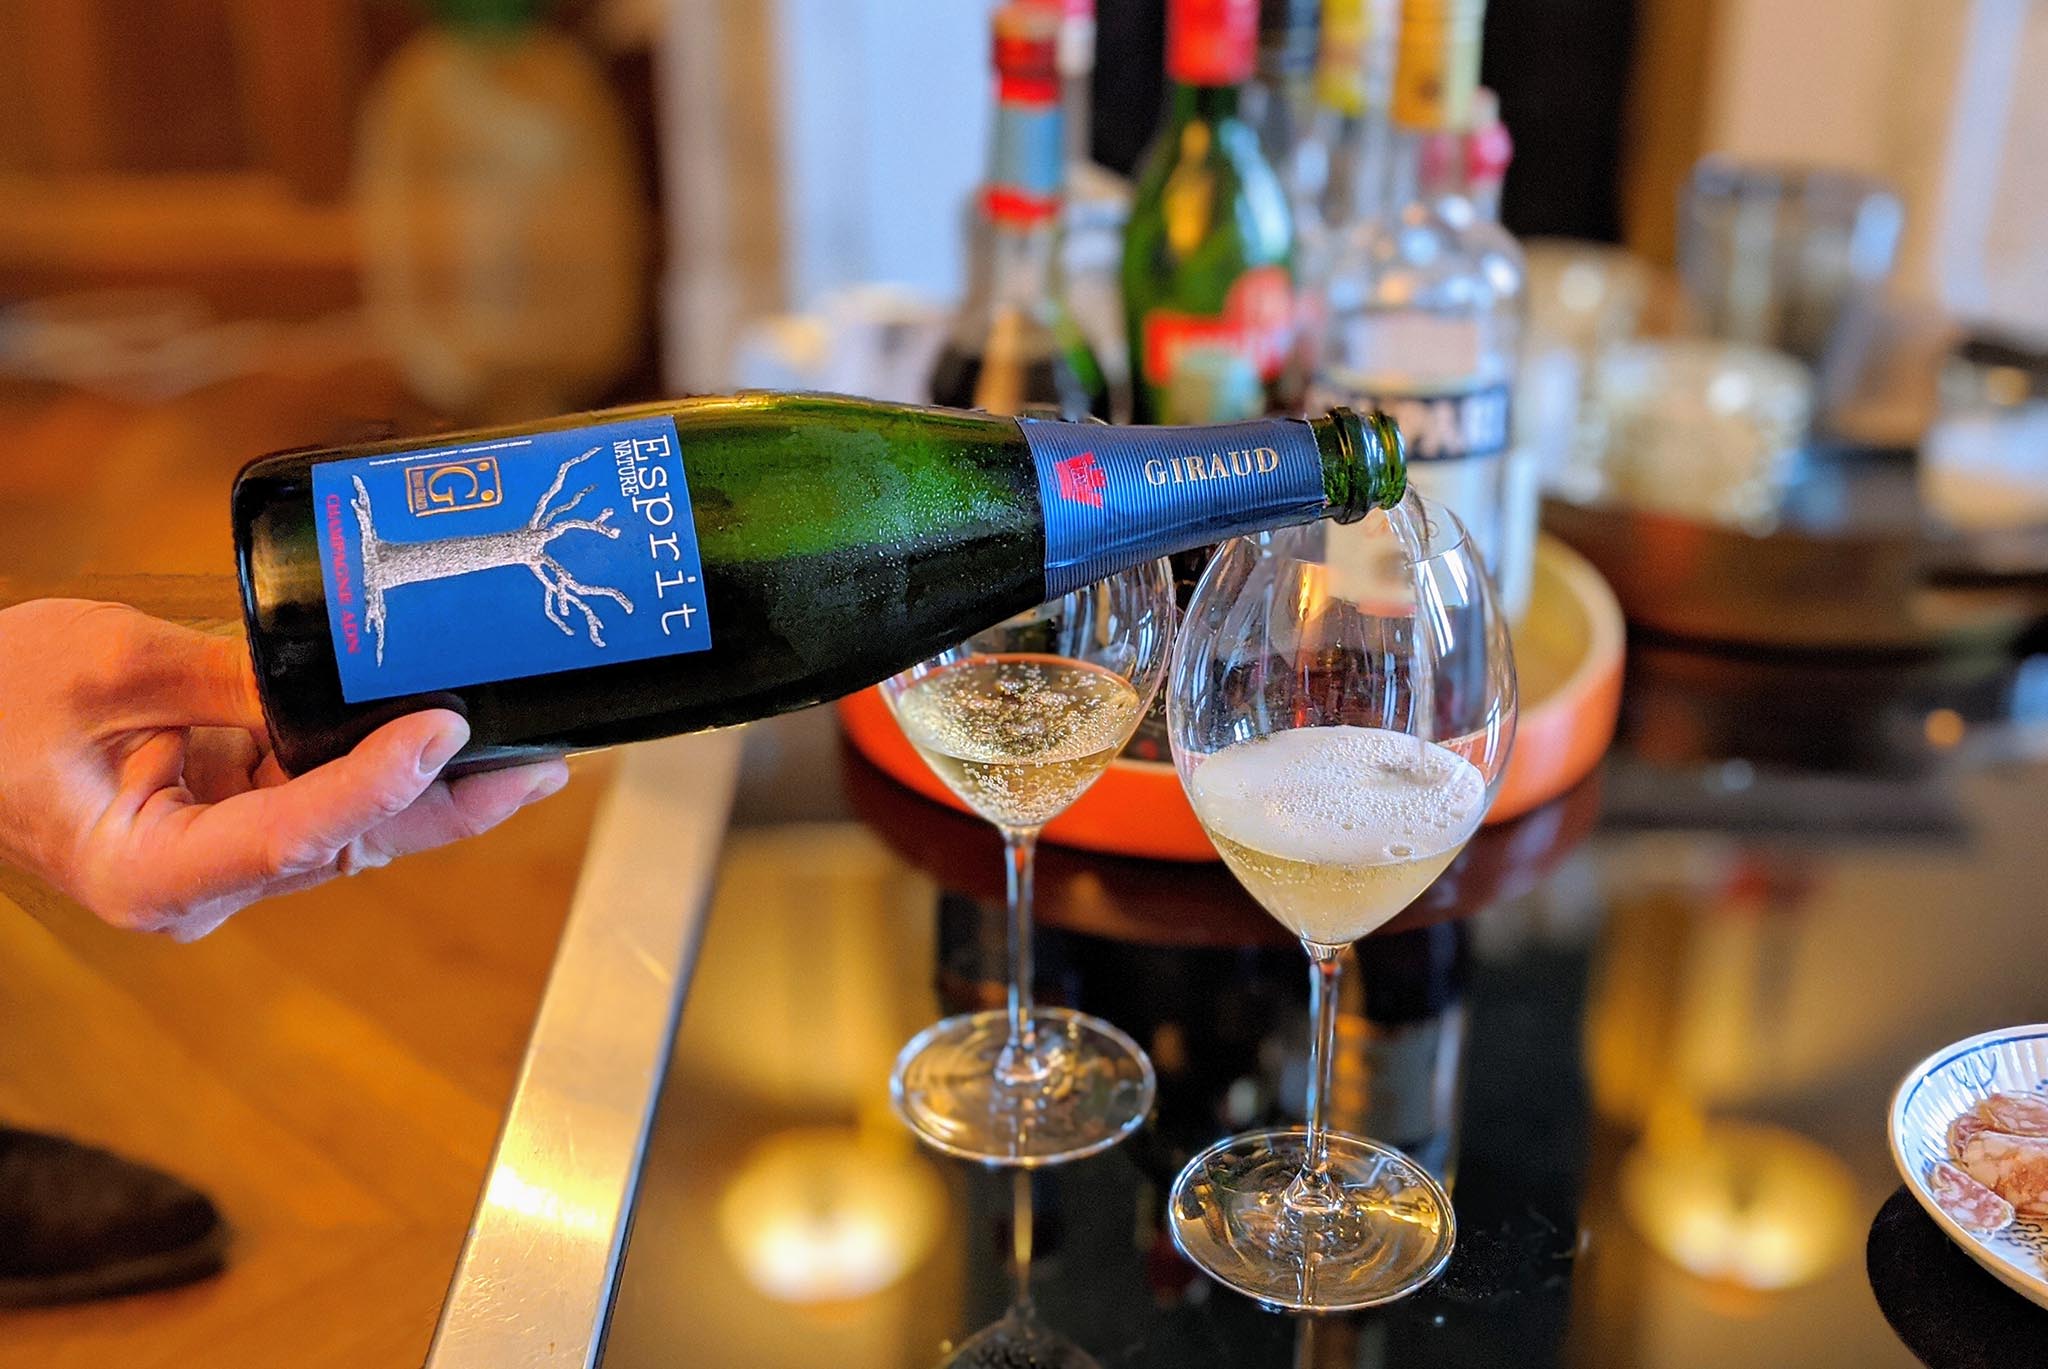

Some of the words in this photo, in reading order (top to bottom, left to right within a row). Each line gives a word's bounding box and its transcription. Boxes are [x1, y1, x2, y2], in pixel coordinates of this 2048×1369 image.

[613, 439, 639, 497] NATURE
[1144, 447, 1279, 486] GIRAUD
[326, 494, 352, 605] CHAMPAGNE
[632, 434, 697, 636] Esprit
